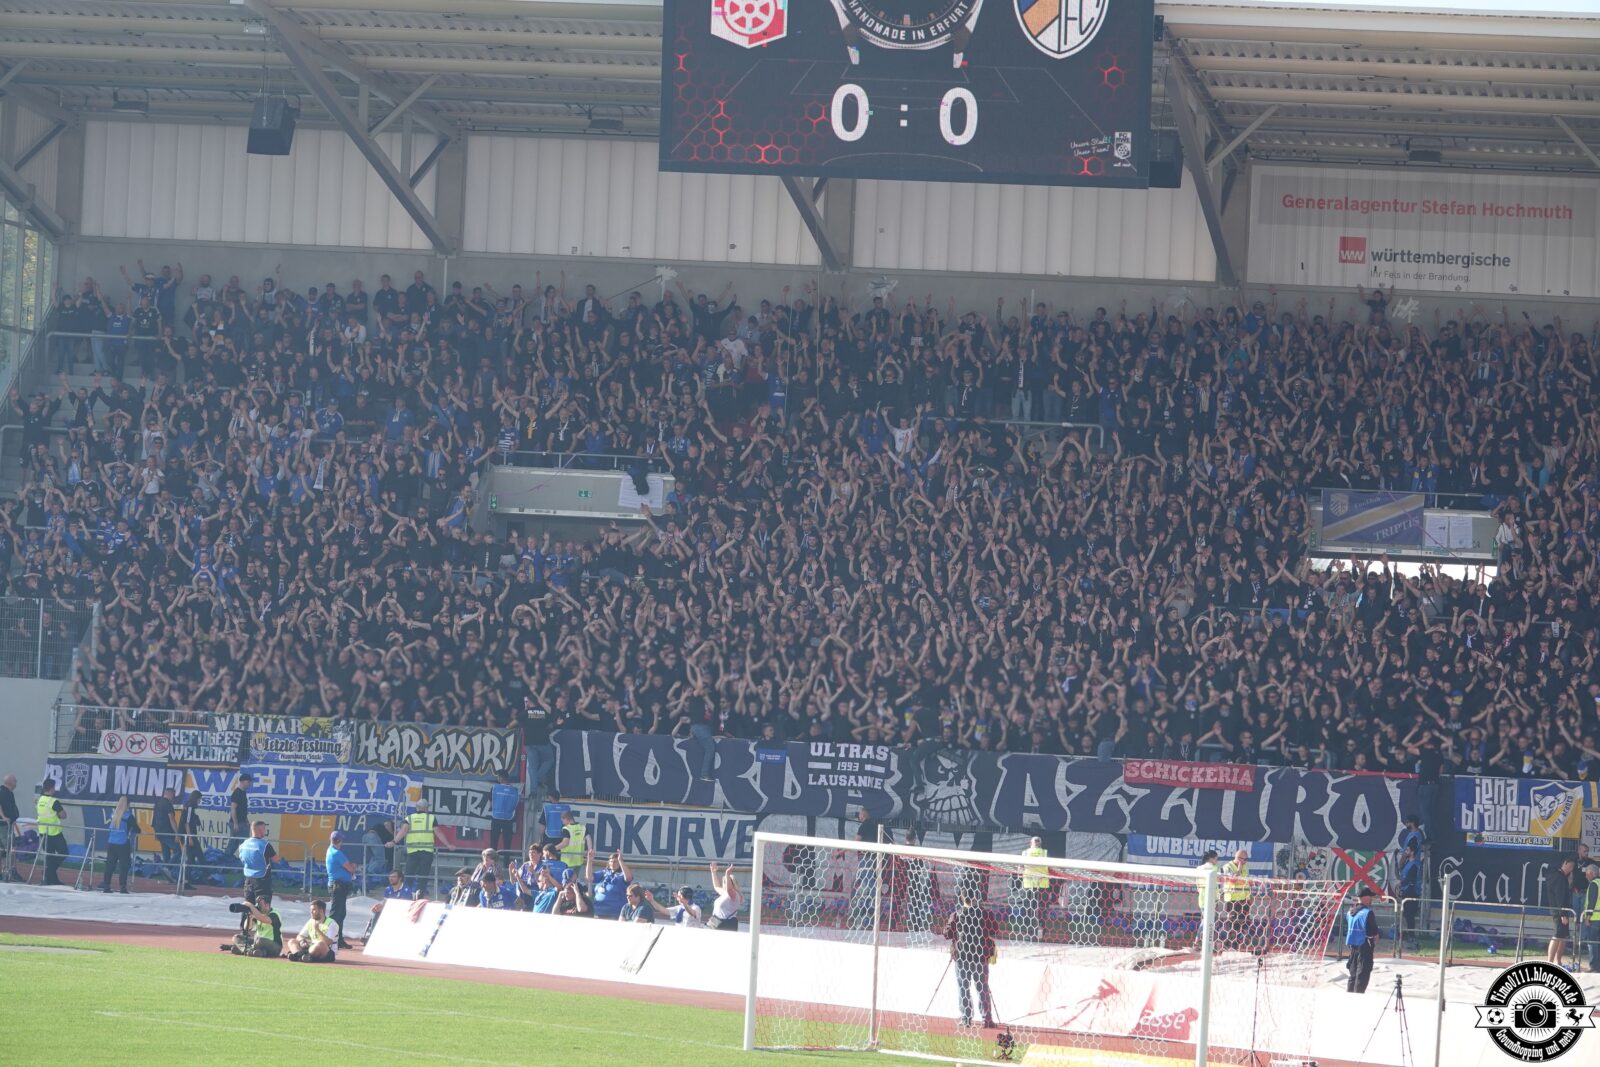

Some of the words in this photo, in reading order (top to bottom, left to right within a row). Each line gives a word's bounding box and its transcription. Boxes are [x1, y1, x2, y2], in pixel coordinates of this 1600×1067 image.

[849, 0, 906, 40] HANDMADE
[912, 30, 926, 40] IN
[929, 2, 969, 36] ERFURT
[830, 83, 870, 142] 0
[938, 87, 978, 146] 0
[1282, 194, 1418, 215] Generalagentur
[1422, 199, 1477, 216] Stefan
[1482, 202, 1573, 220] Hochmuth
[1371, 249, 1511, 268] württembergische
[1384, 271, 1400, 279] Fels
[1403, 271, 1411, 279] in
[1413, 272, 1426, 281] der
[213, 713, 304, 735] WEIMAR
[170, 728, 242, 747] REFUGEES
[355, 722, 516, 771] HARAKIRI
[169, 745, 240, 762] WELCOME
[809, 741, 889, 762] ULTRAS
[837, 761, 860, 772] 1993
[1125, 760, 1254, 786] SCHICKERIA
[114, 765, 183, 797] MIND
[192, 766, 408, 802] WEIMAR
[807, 773, 884, 789] LAUSANNE
[300, 814, 367, 832] JENA
